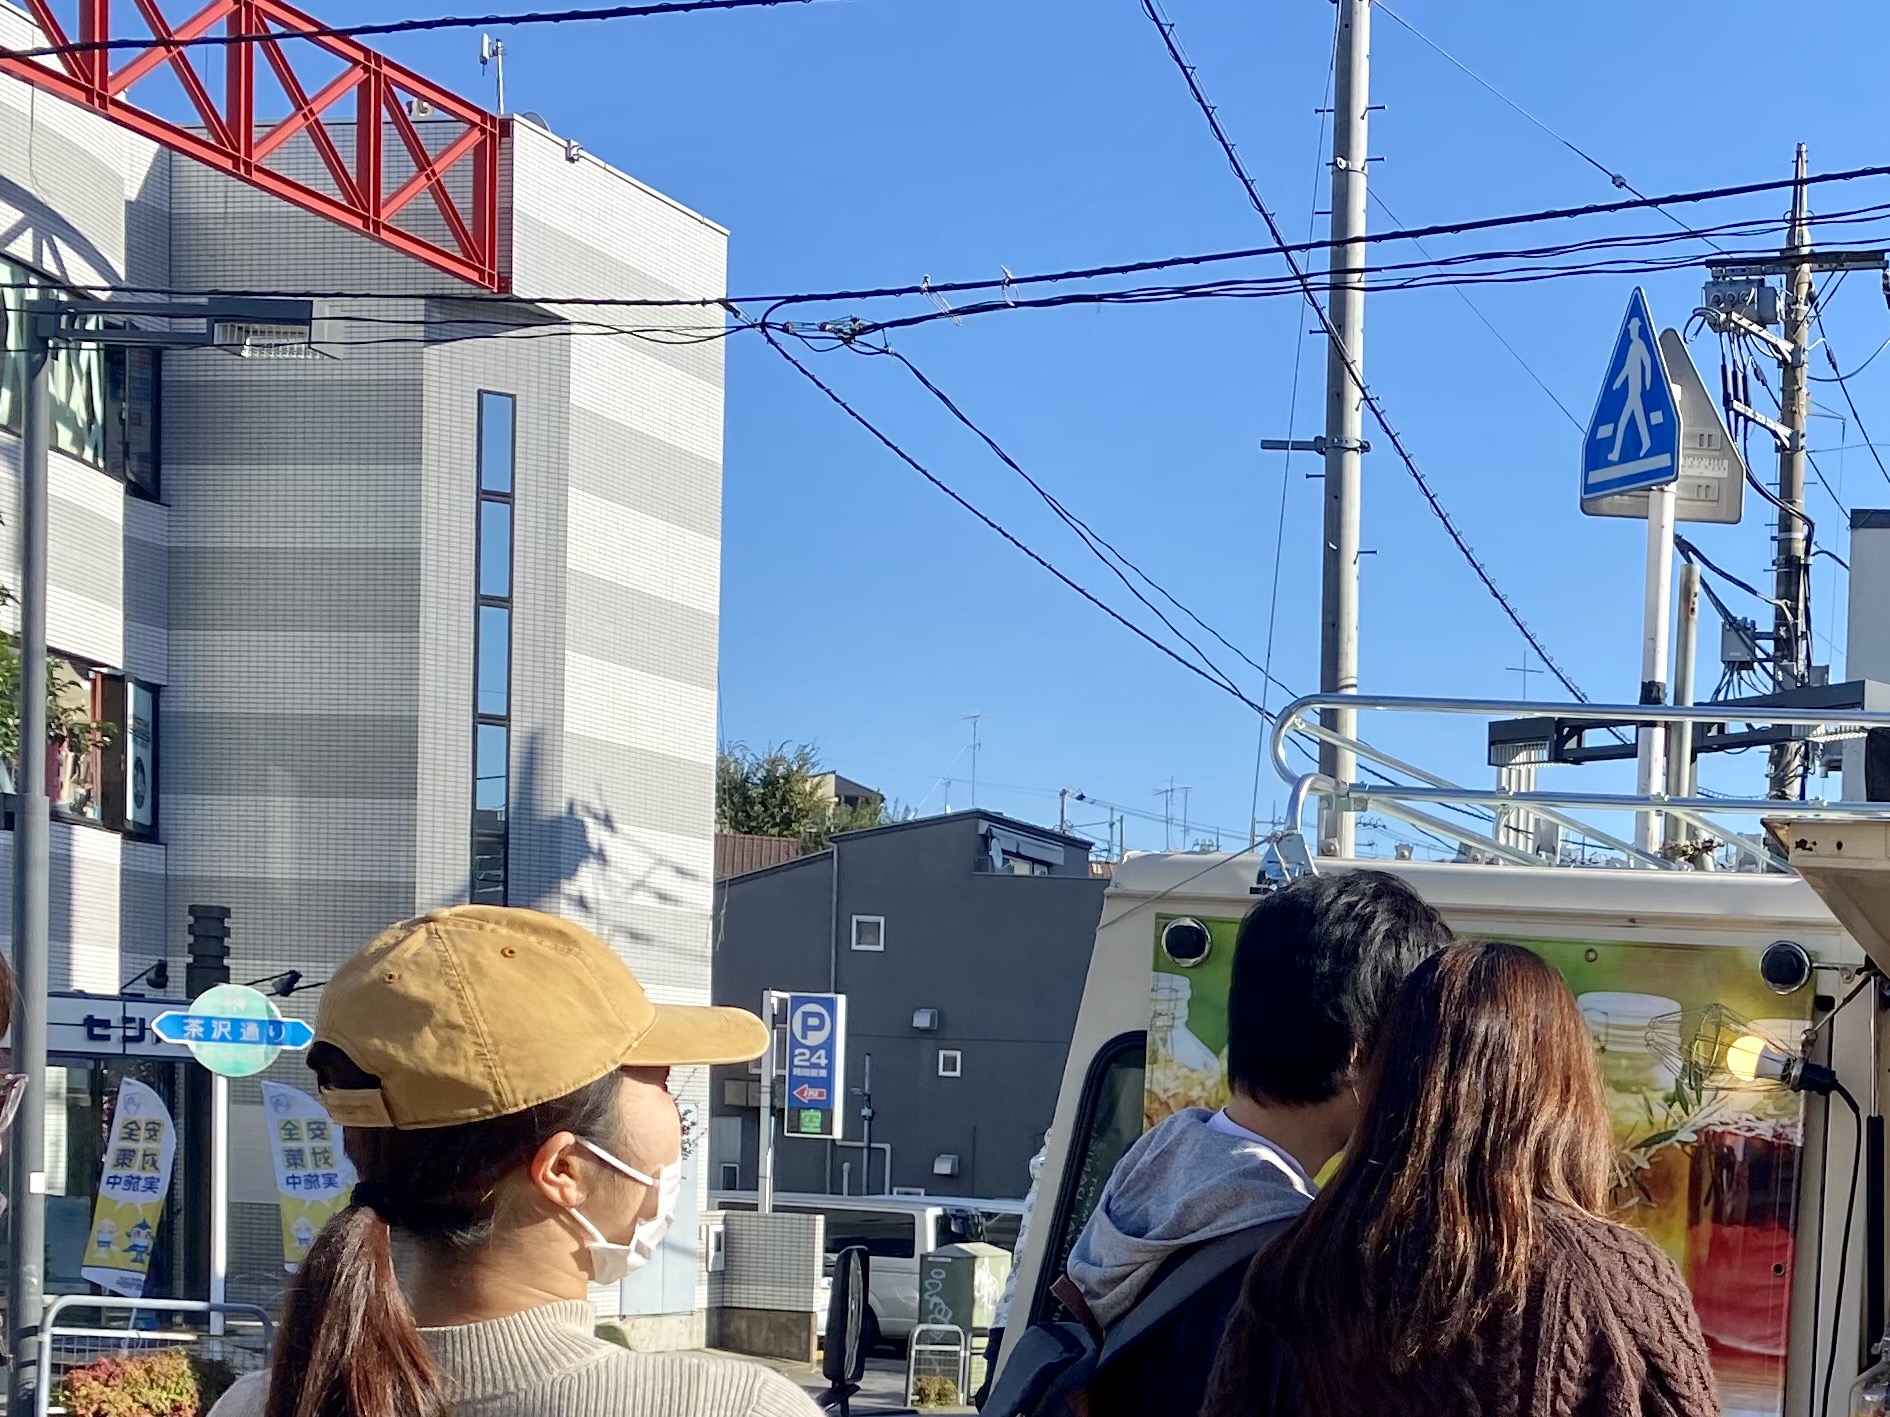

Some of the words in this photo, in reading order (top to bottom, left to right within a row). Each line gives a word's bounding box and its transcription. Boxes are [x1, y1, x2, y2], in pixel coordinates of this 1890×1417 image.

[182, 1018, 287, 1044] 茶沢通り
[801, 1011, 826, 1040] P
[793, 1048, 829, 1067] 24
